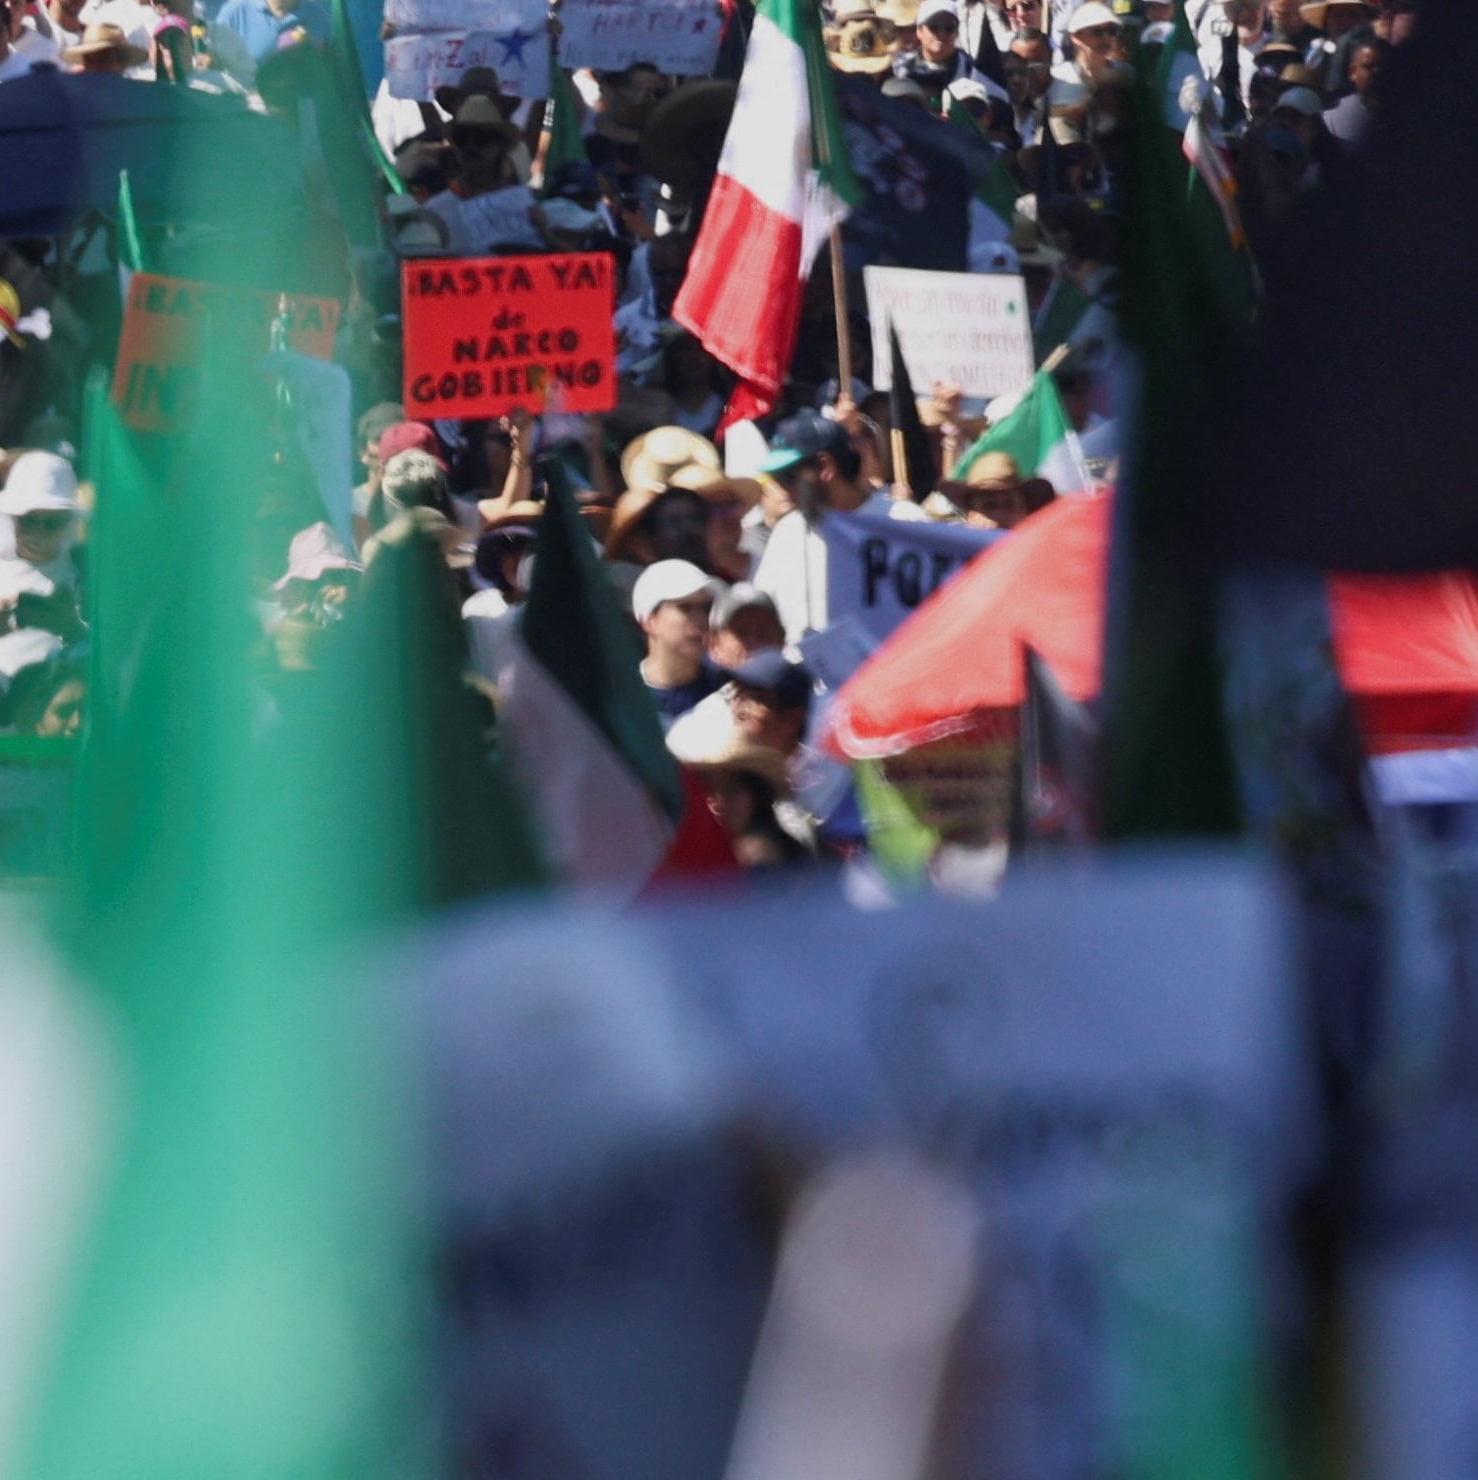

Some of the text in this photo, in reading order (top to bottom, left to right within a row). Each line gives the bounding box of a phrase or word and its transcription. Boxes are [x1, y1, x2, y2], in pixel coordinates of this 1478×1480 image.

[549, 259, 605, 290] YA!
[492, 305, 526, 331] de
[453, 328, 578, 363] NARCO
